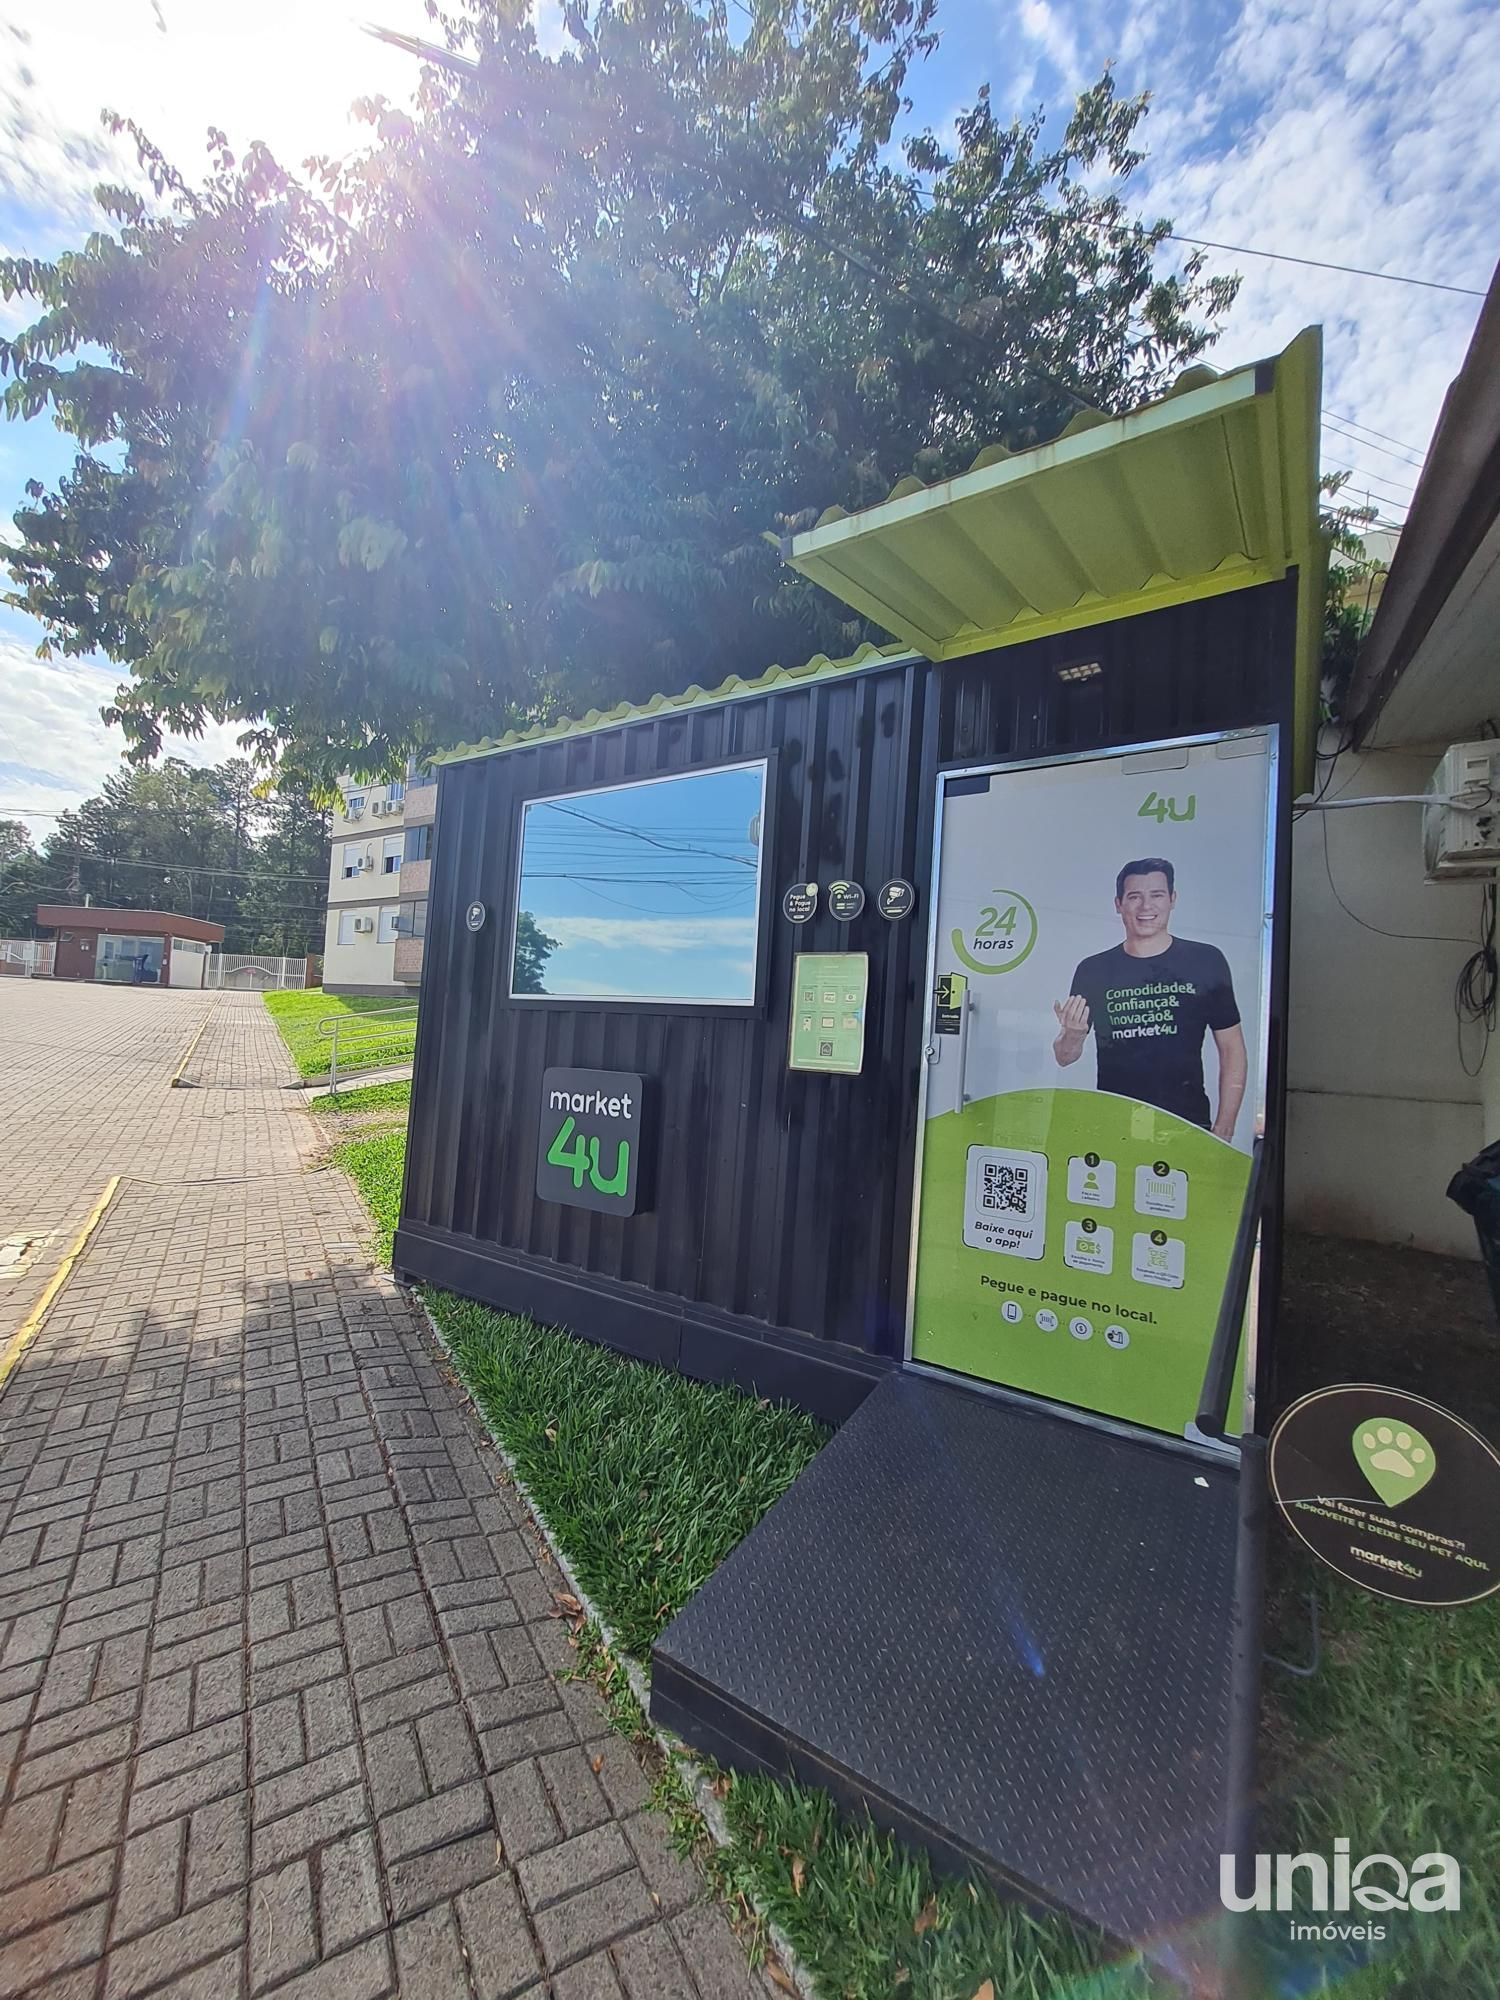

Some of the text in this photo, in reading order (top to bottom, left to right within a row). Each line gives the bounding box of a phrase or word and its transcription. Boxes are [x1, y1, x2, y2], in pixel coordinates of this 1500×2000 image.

[975, 906, 1017, 937] 24
[973, 938, 1014, 951] horas
[1112, 1023, 1178, 1040] market4u
[549, 1090, 632, 1119] market
[974, 1221, 1034, 1240] Baixe aqui
[985, 1236, 1020, 1249] o app!
[980, 1275, 1158, 1325] Pegue e pague no local.
[1317, 1495, 1335, 1509] Vai
[1337, 1502, 1367, 1519] fazer
[1369, 1513, 1397, 1528] suas
[1295, 1501, 1355, 1527] APROVEITE
[1357, 1521, 1365, 1529] E
[1367, 1524, 1402, 1541] DEIXE
[1404, 1535, 1427, 1550] SEU
[1429, 1544, 1452, 1558] PET
[1350, 1546, 1422, 1578] market4u
